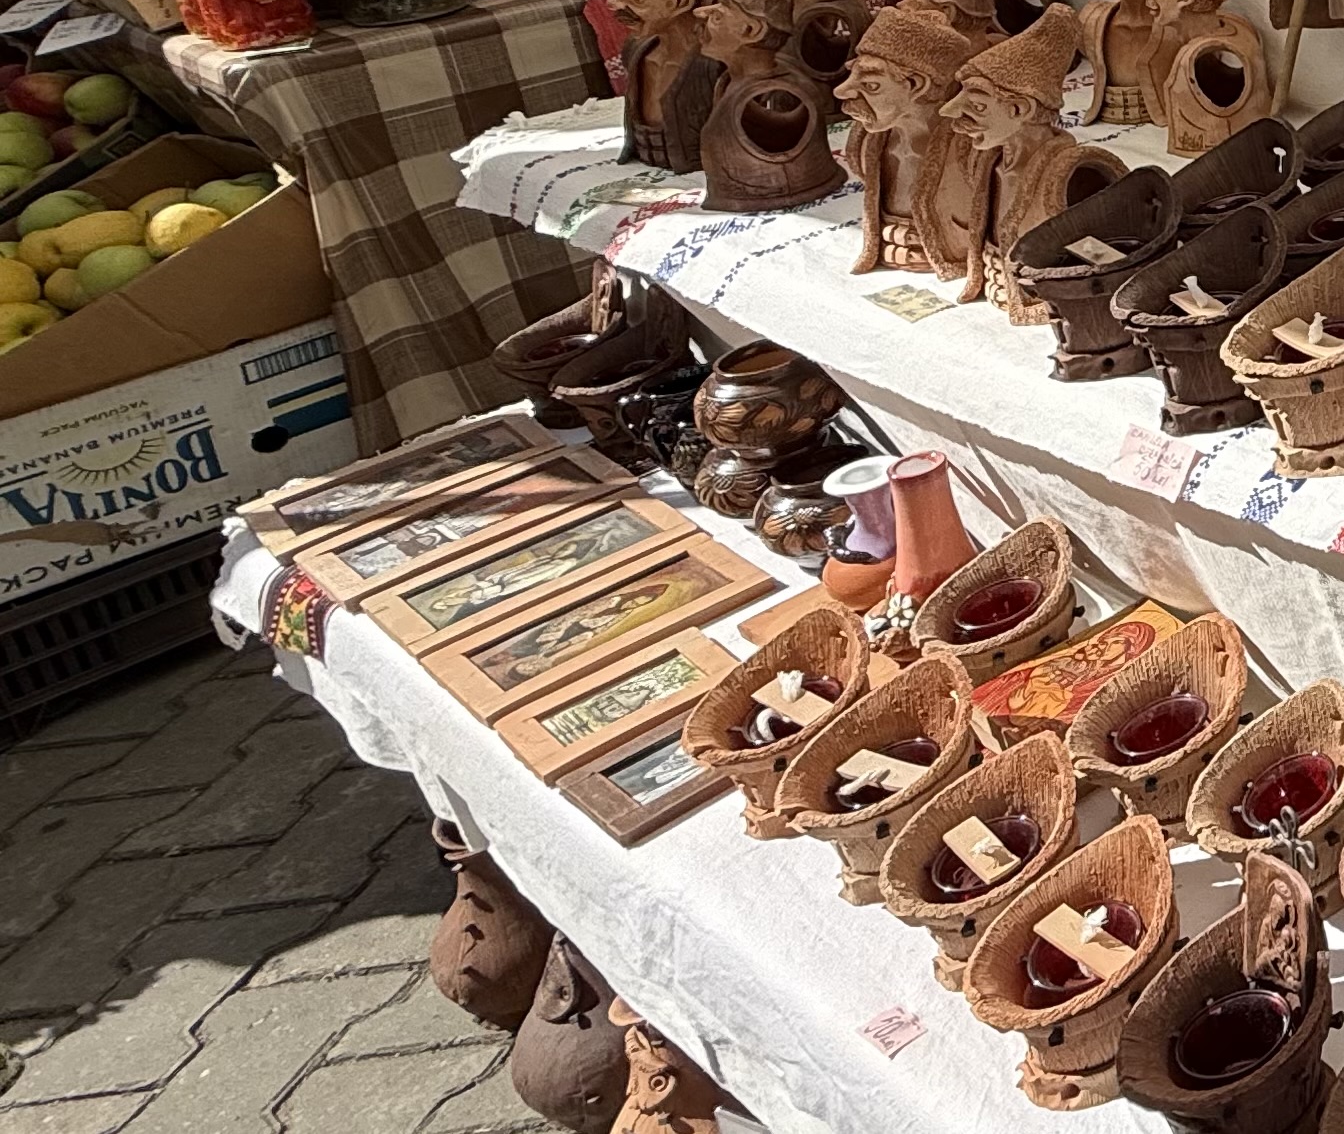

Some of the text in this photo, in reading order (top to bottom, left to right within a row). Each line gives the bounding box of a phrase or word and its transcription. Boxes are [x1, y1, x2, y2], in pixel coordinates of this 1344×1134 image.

[40, 399, 149, 438] VACUUM PACK
[108, 405, 208, 445] PREMIUM
[0, 424, 229, 527] BONITA
[0, 548, 95, 595] PACK
